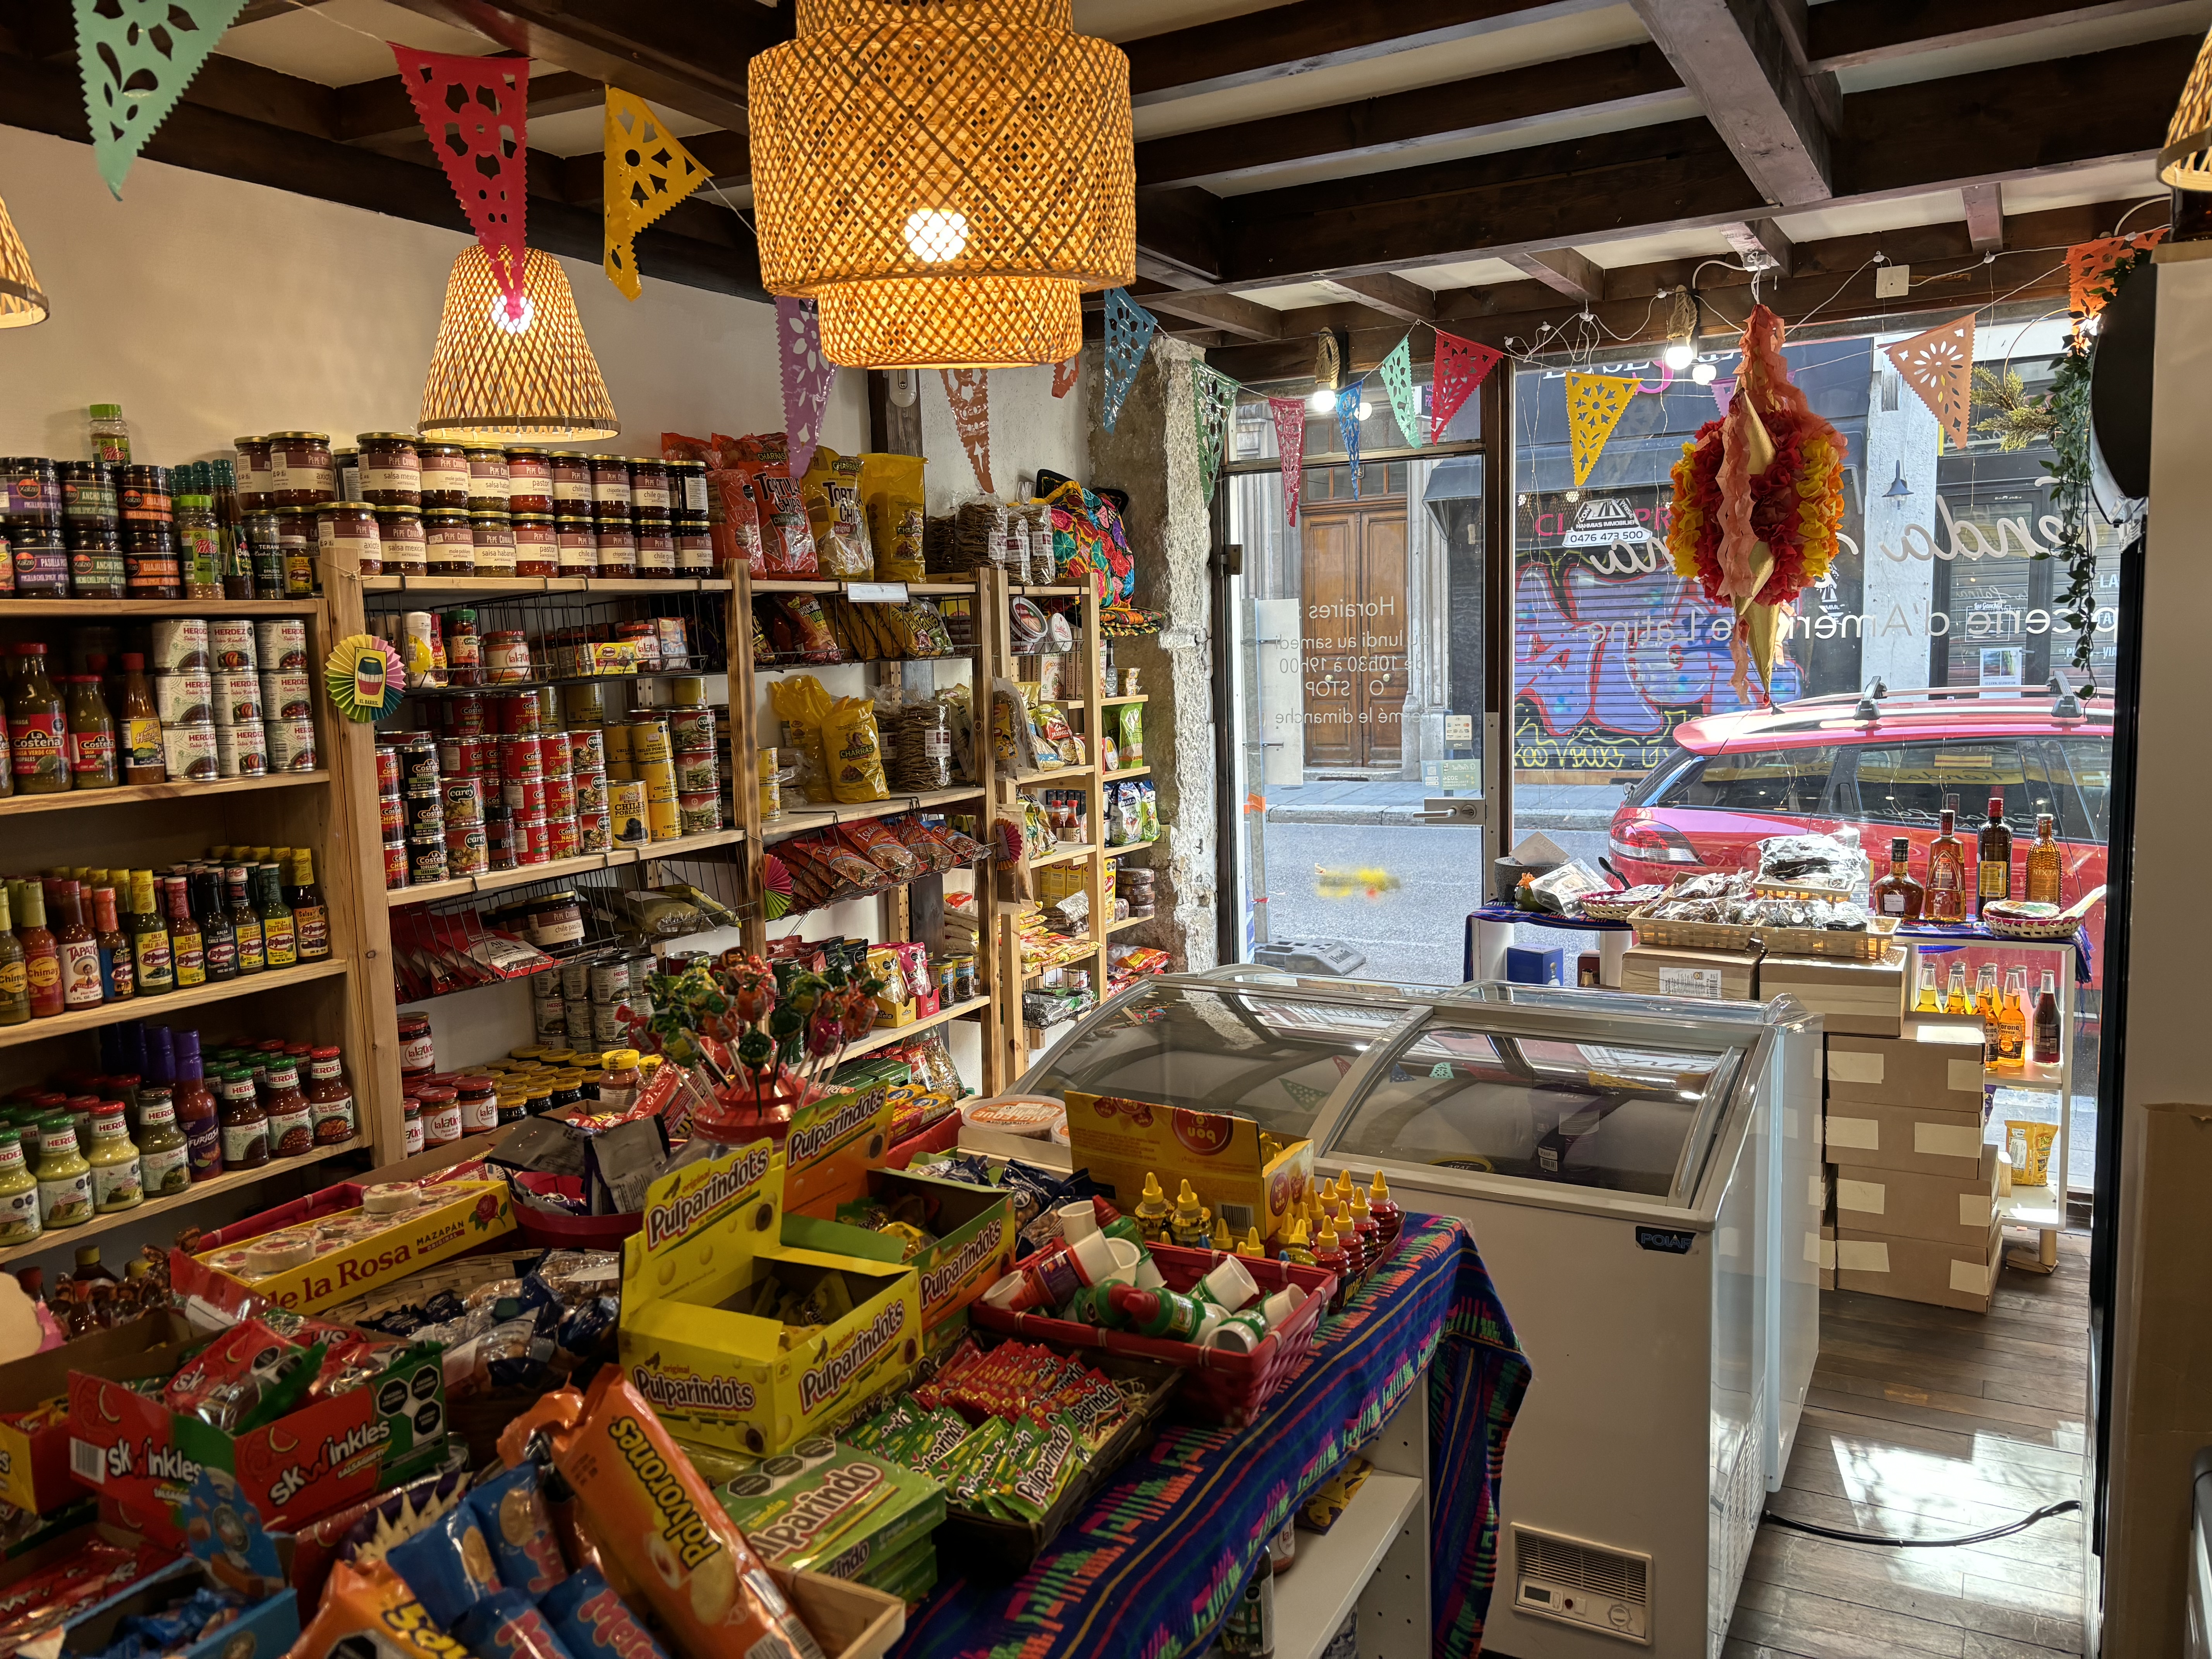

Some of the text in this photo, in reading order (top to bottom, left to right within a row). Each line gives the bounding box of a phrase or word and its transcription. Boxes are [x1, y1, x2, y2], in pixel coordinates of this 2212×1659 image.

[308, 455, 319, 464] PEPE
[389, 456, 400, 465] PEPE
[758, 452, 787, 461] CHARRAS
[441, 459, 452, 467] PEPE
[833, 462, 860, 472] CHARRAS
[532, 479, 549, 488] pastor
[82, 492, 100, 500] ANCHO
[776, 495, 804, 513] CHIPS
[840, 505, 862, 523] CHIPS
[356, 525, 368, 534] PEPE
[393, 529, 405, 537] PEPE
[445, 532, 456, 541] PEPE
[487, 535, 497, 543] PEPE
[534, 532, 544, 541] PEPE
[1571, 534, 1596, 542] 0476
[1623, 531, 1643, 539] 500
[539, 546, 555, 554] pastor
[41, 558, 60, 567] PASILLA
[96, 561, 112, 570] ANCHO
[144, 562, 166, 572] GUAJILLO
[183, 627, 208, 635] HERDEZ
[214, 628, 246, 636] HERDEZ
[230, 680, 258, 688] HERDEZ
[31, 732, 43, 740] La
[189, 733, 215, 742] HERDEZ
[237, 732, 264, 740] HERDEZ
[12, 737, 63, 748] Costeña
[83, 740, 114, 749] Costeña
[840, 745, 873, 758] CHARRAS
[450, 788, 474, 799] carey
[615, 802, 645, 811] CHILES
[467, 835, 486, 846] carey
[553, 912, 564, 921] PEPE
[555, 925, 567, 933] chile
[28, 968, 58, 977] Chimay
[1999, 1023, 2020, 1031] Corona
[312, 1064, 342, 1075] HERDEZ
[269, 1073, 298, 1084] HERDEZ
[787, 1087, 886, 1169] Pulparindots
[682, 1167, 710, 1194] original
[647, 1147, 769, 1252] Pulparindots
[416, 1220, 465, 1246] MAZAPÁN
[427, 1232, 458, 1251] ORIGINAL
[919, 1217, 1003, 1310] Pulparindots
[269, 1244, 412, 1310] de la Rosa
[831, 1327, 855, 1355] original
[799, 1299, 905, 1416] Pulparindots
[663, 1365, 690, 1374] original
[633, 1365, 756, 1410] Pulparindots
[1015, 1422, 1073, 1507] Pulparindo
[609, 1415, 721, 1571] Polvorones
